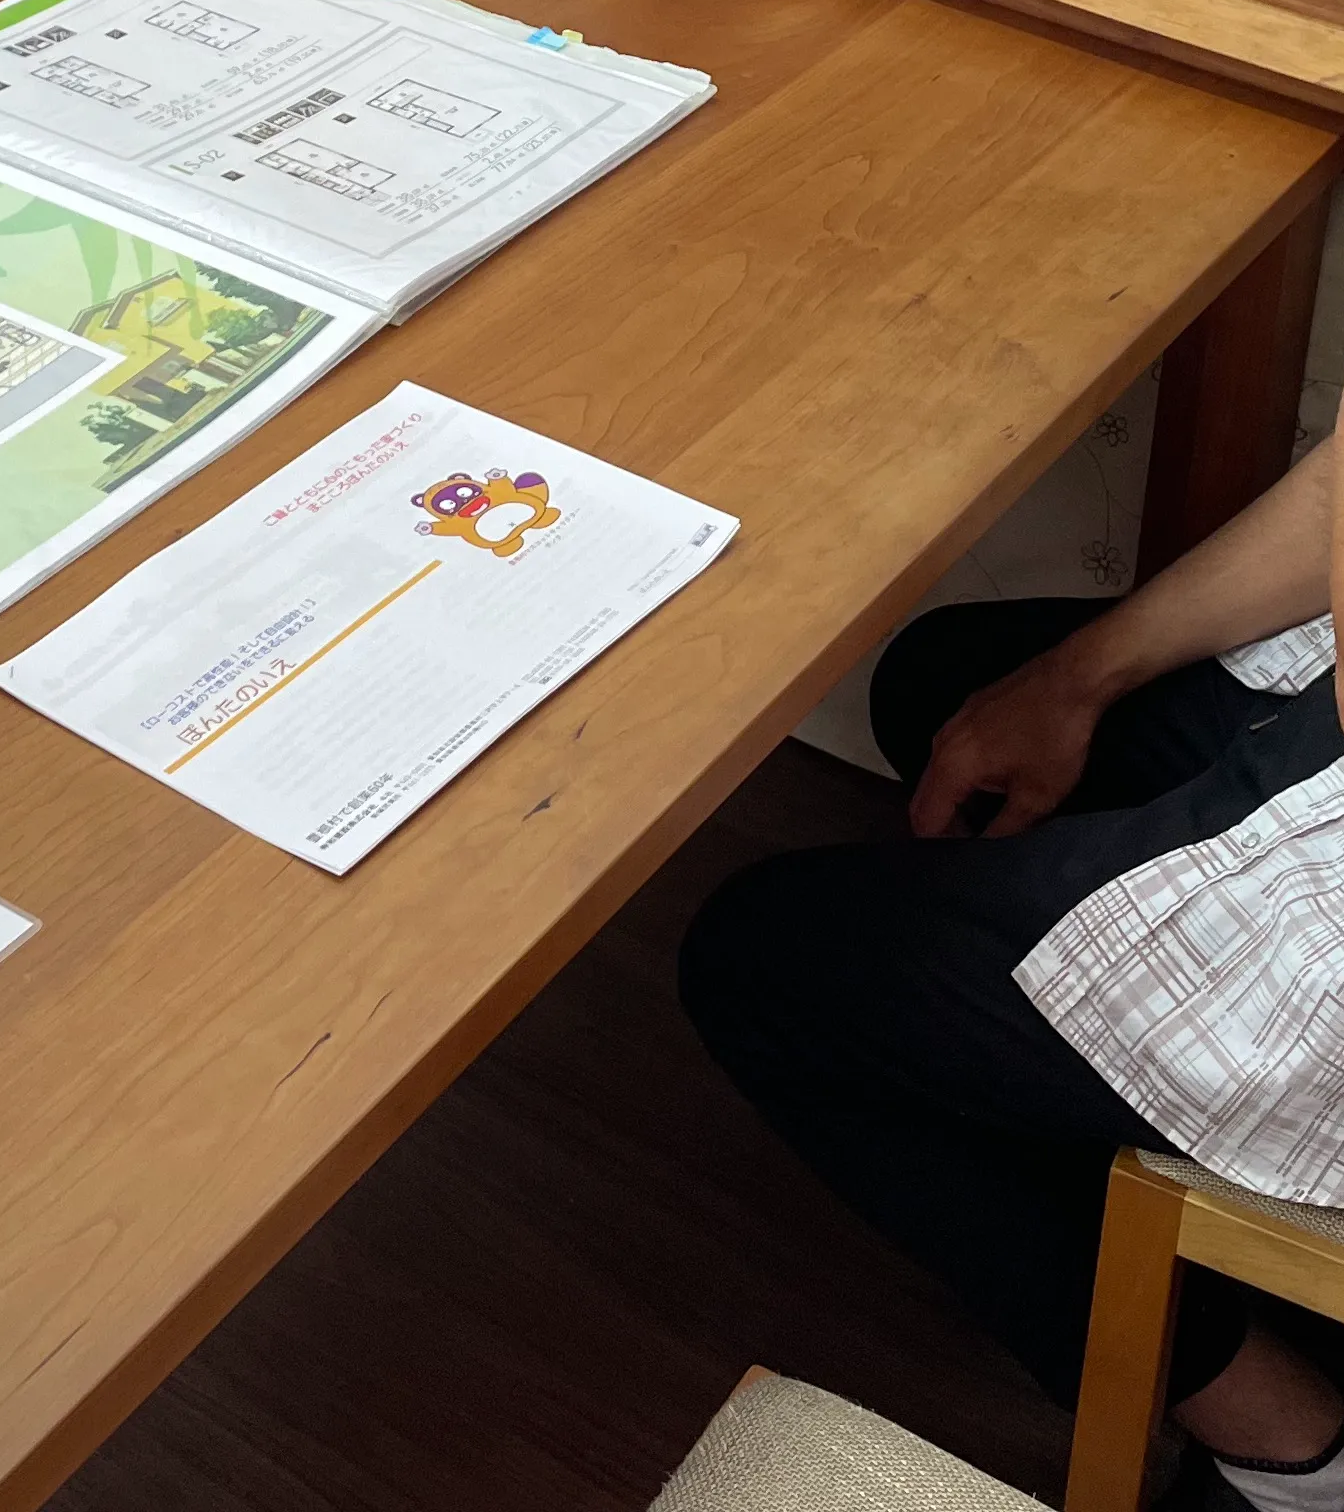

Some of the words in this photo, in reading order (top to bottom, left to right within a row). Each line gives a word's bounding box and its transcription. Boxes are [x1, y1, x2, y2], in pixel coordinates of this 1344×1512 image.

[188, 148, 226, 172] S-02
[176, 658, 297, 745] ぽんたのいえ
